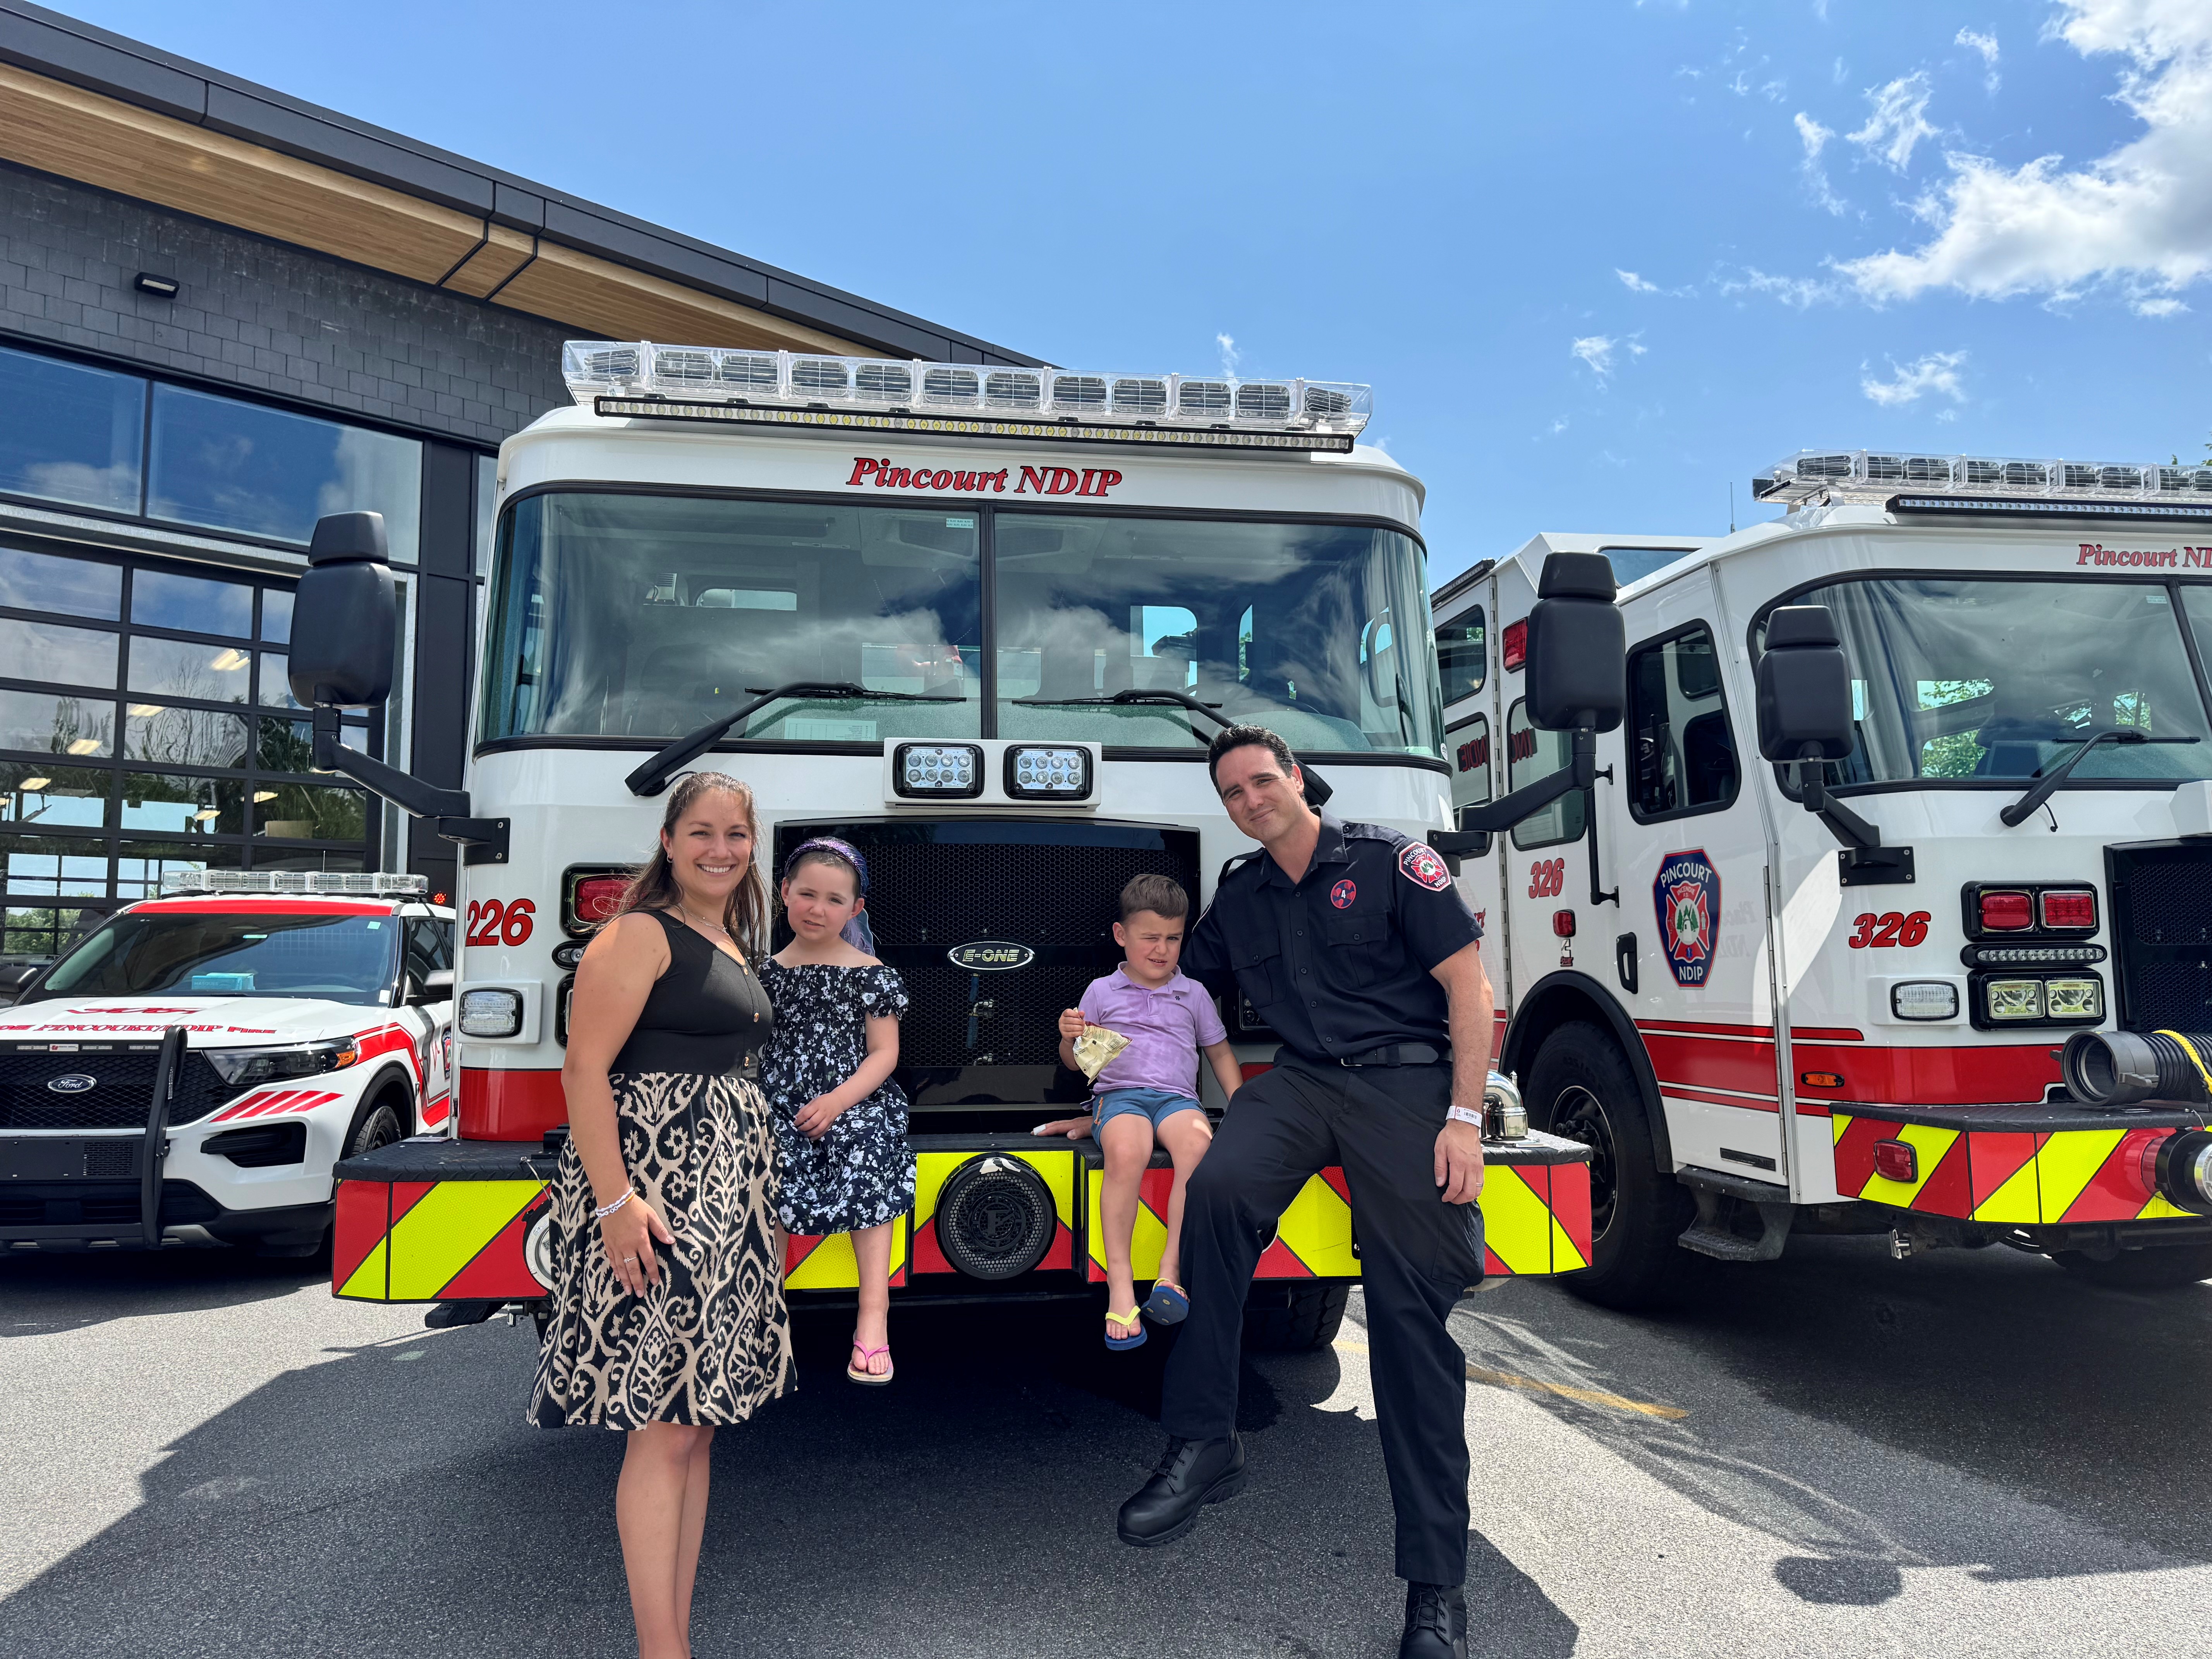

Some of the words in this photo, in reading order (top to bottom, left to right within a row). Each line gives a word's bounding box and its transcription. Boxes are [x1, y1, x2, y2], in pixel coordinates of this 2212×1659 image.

[846, 457, 1008, 492] Pincourt
[1014, 466, 1122, 497] NDIP
[2076, 544, 2177, 567] Pincourt
[1403, 847, 1427, 866] PINCOURT
[1434, 876, 1446, 888] NDIP
[1528, 857, 1565, 899] 326
[1660, 862, 1712, 888] PINCOURT
[1341, 890, 1346, 898] 4
[1677, 886, 1695, 896] INCENDIE
[465, 898, 536, 947] 226
[1849, 910, 1932, 949] 326
[962, 949, 1019, 962] E-ONE
[1679, 966, 1704, 981] NDIP
[58, 1079, 83, 1089] Ford
